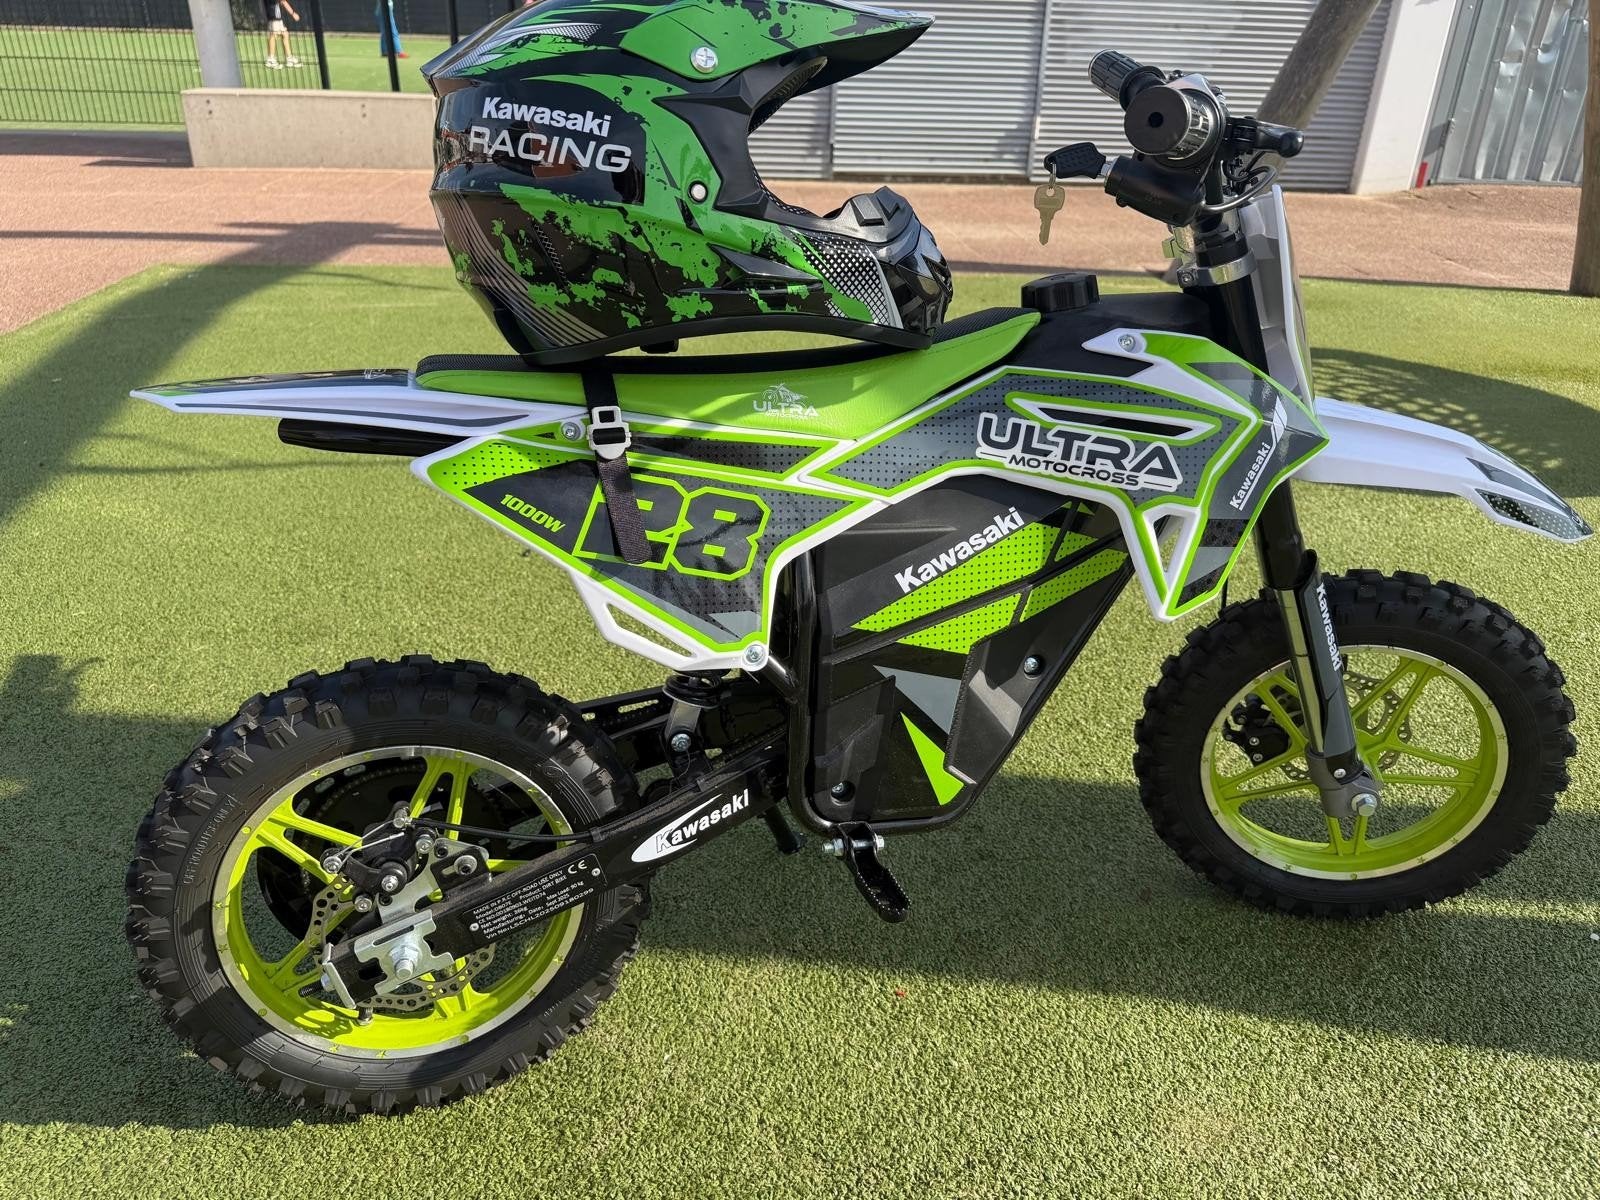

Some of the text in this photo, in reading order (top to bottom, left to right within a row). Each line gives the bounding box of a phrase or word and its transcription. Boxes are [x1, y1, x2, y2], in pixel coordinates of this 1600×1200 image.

[482, 96, 611, 138] Kawasaki
[468, 123, 632, 174] RACING
[753, 400, 819, 417] ULTRA
[980, 413, 1179, 485] ULTRA
[1008, 454, 1140, 488] MOTOCROSS
[1229, 441, 1271, 510] Kawasaki
[499, 492, 567, 535] 1000W
[894, 506, 1026, 594] Kawasaki
[1315, 582, 1342, 672] Kawasaki
[655, 788, 750, 854] Kawasaki
[541, 880, 554, 890] DIRT
[567, 859, 588, 874] CE
[473, 905, 489, 914] MADE
[511, 882, 538, 898] OFF-ROAD
[538, 876, 549, 886] USE
[548, 869, 563, 880] ONLY
[480, 921, 492, 929] Net
[546, 893, 557, 901] Max
[545, 899, 558, 908] Sept
[486, 932, 497, 940] Vin
